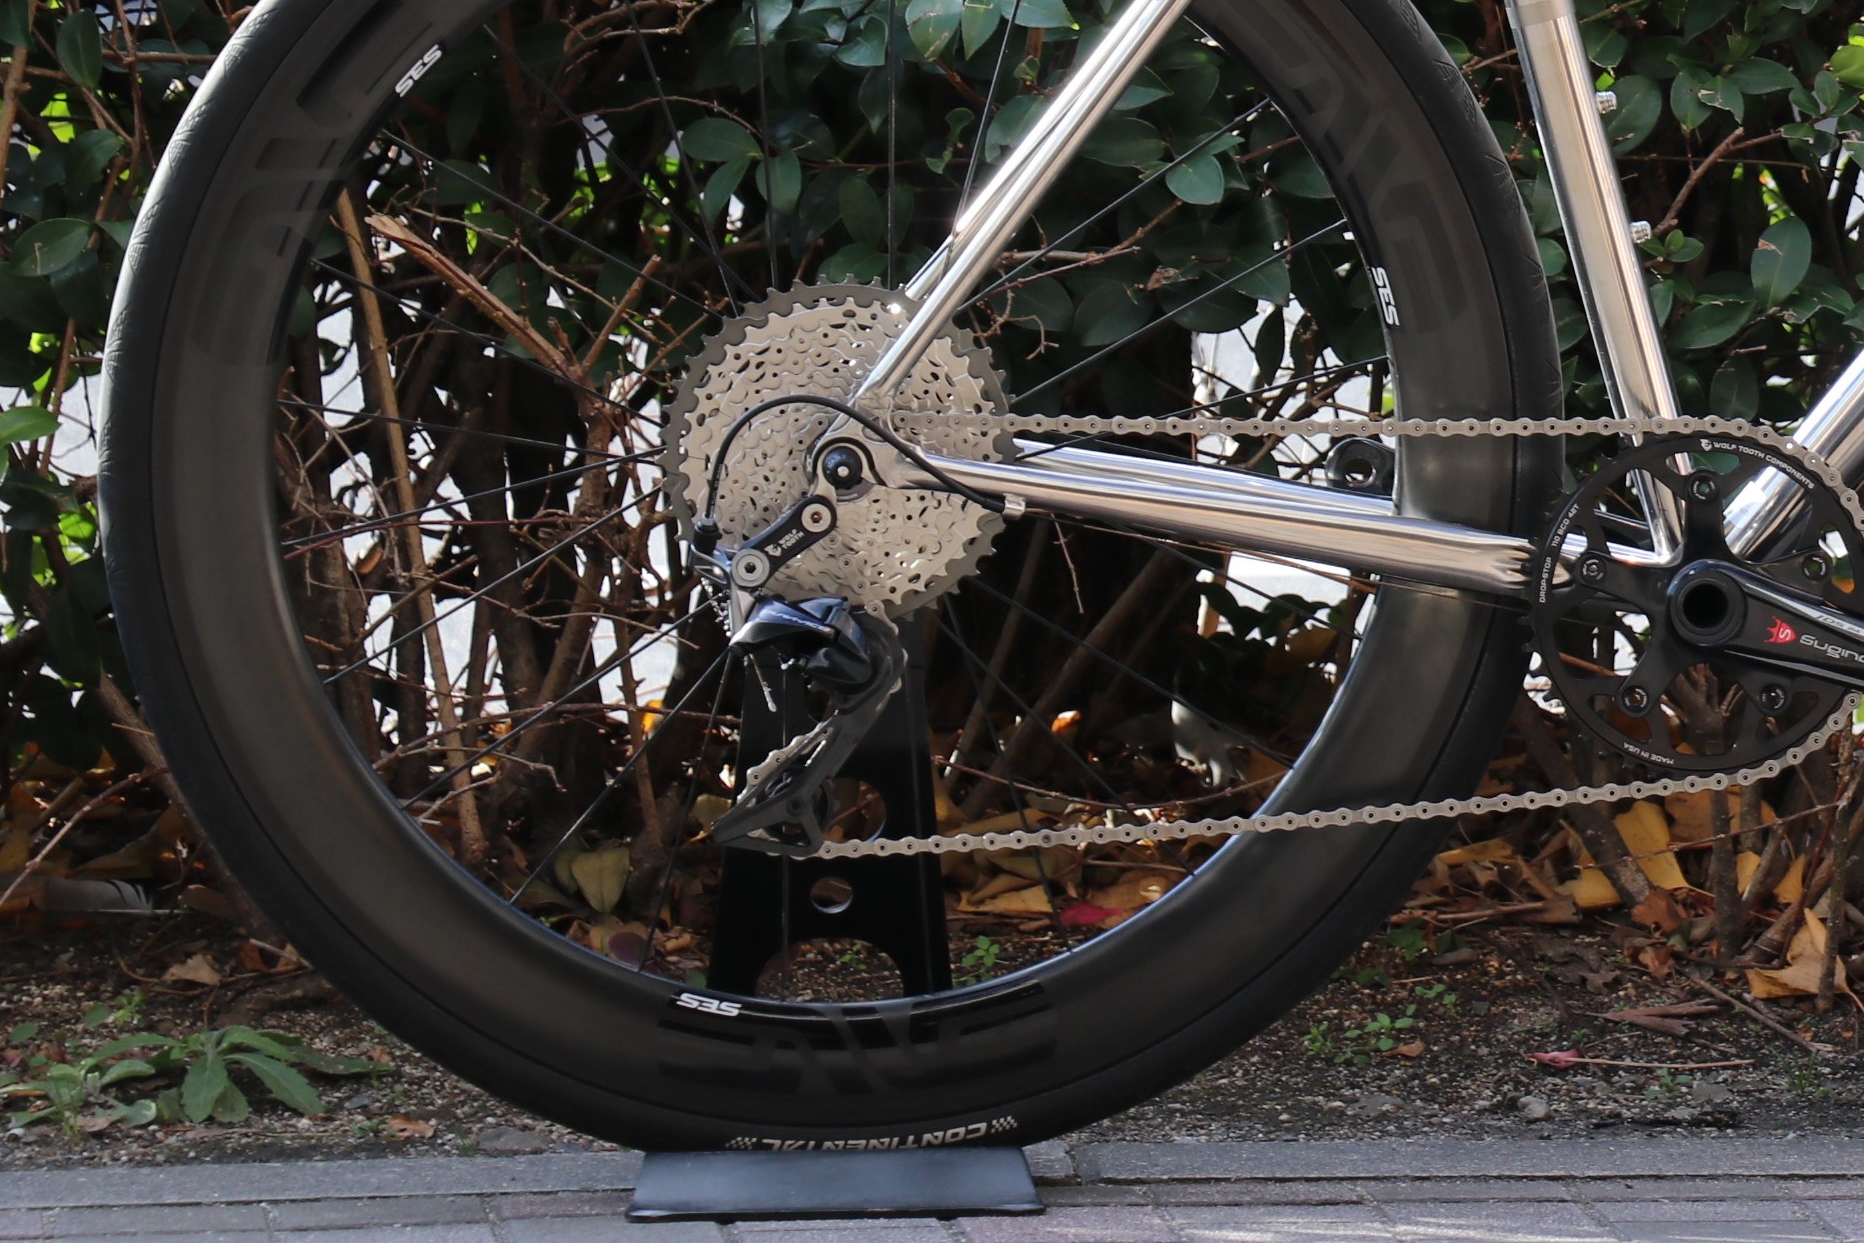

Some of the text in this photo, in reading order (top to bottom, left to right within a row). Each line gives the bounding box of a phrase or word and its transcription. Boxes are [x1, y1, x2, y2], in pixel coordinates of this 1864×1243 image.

[394, 44, 442, 98] SES
[1371, 266, 1400, 326] SES
[1712, 441, 1815, 490] WOLF TOOTH COMPONENTS
[778, 528, 798, 545] WOLF
[1557, 518, 1570, 535] BCD
[782, 531, 805, 550] TOOTH
[1539, 556, 1552, 603] DROP-STOP
[1623, 742, 1675, 765] MADE IN USA
[675, 991, 742, 1017] SES
